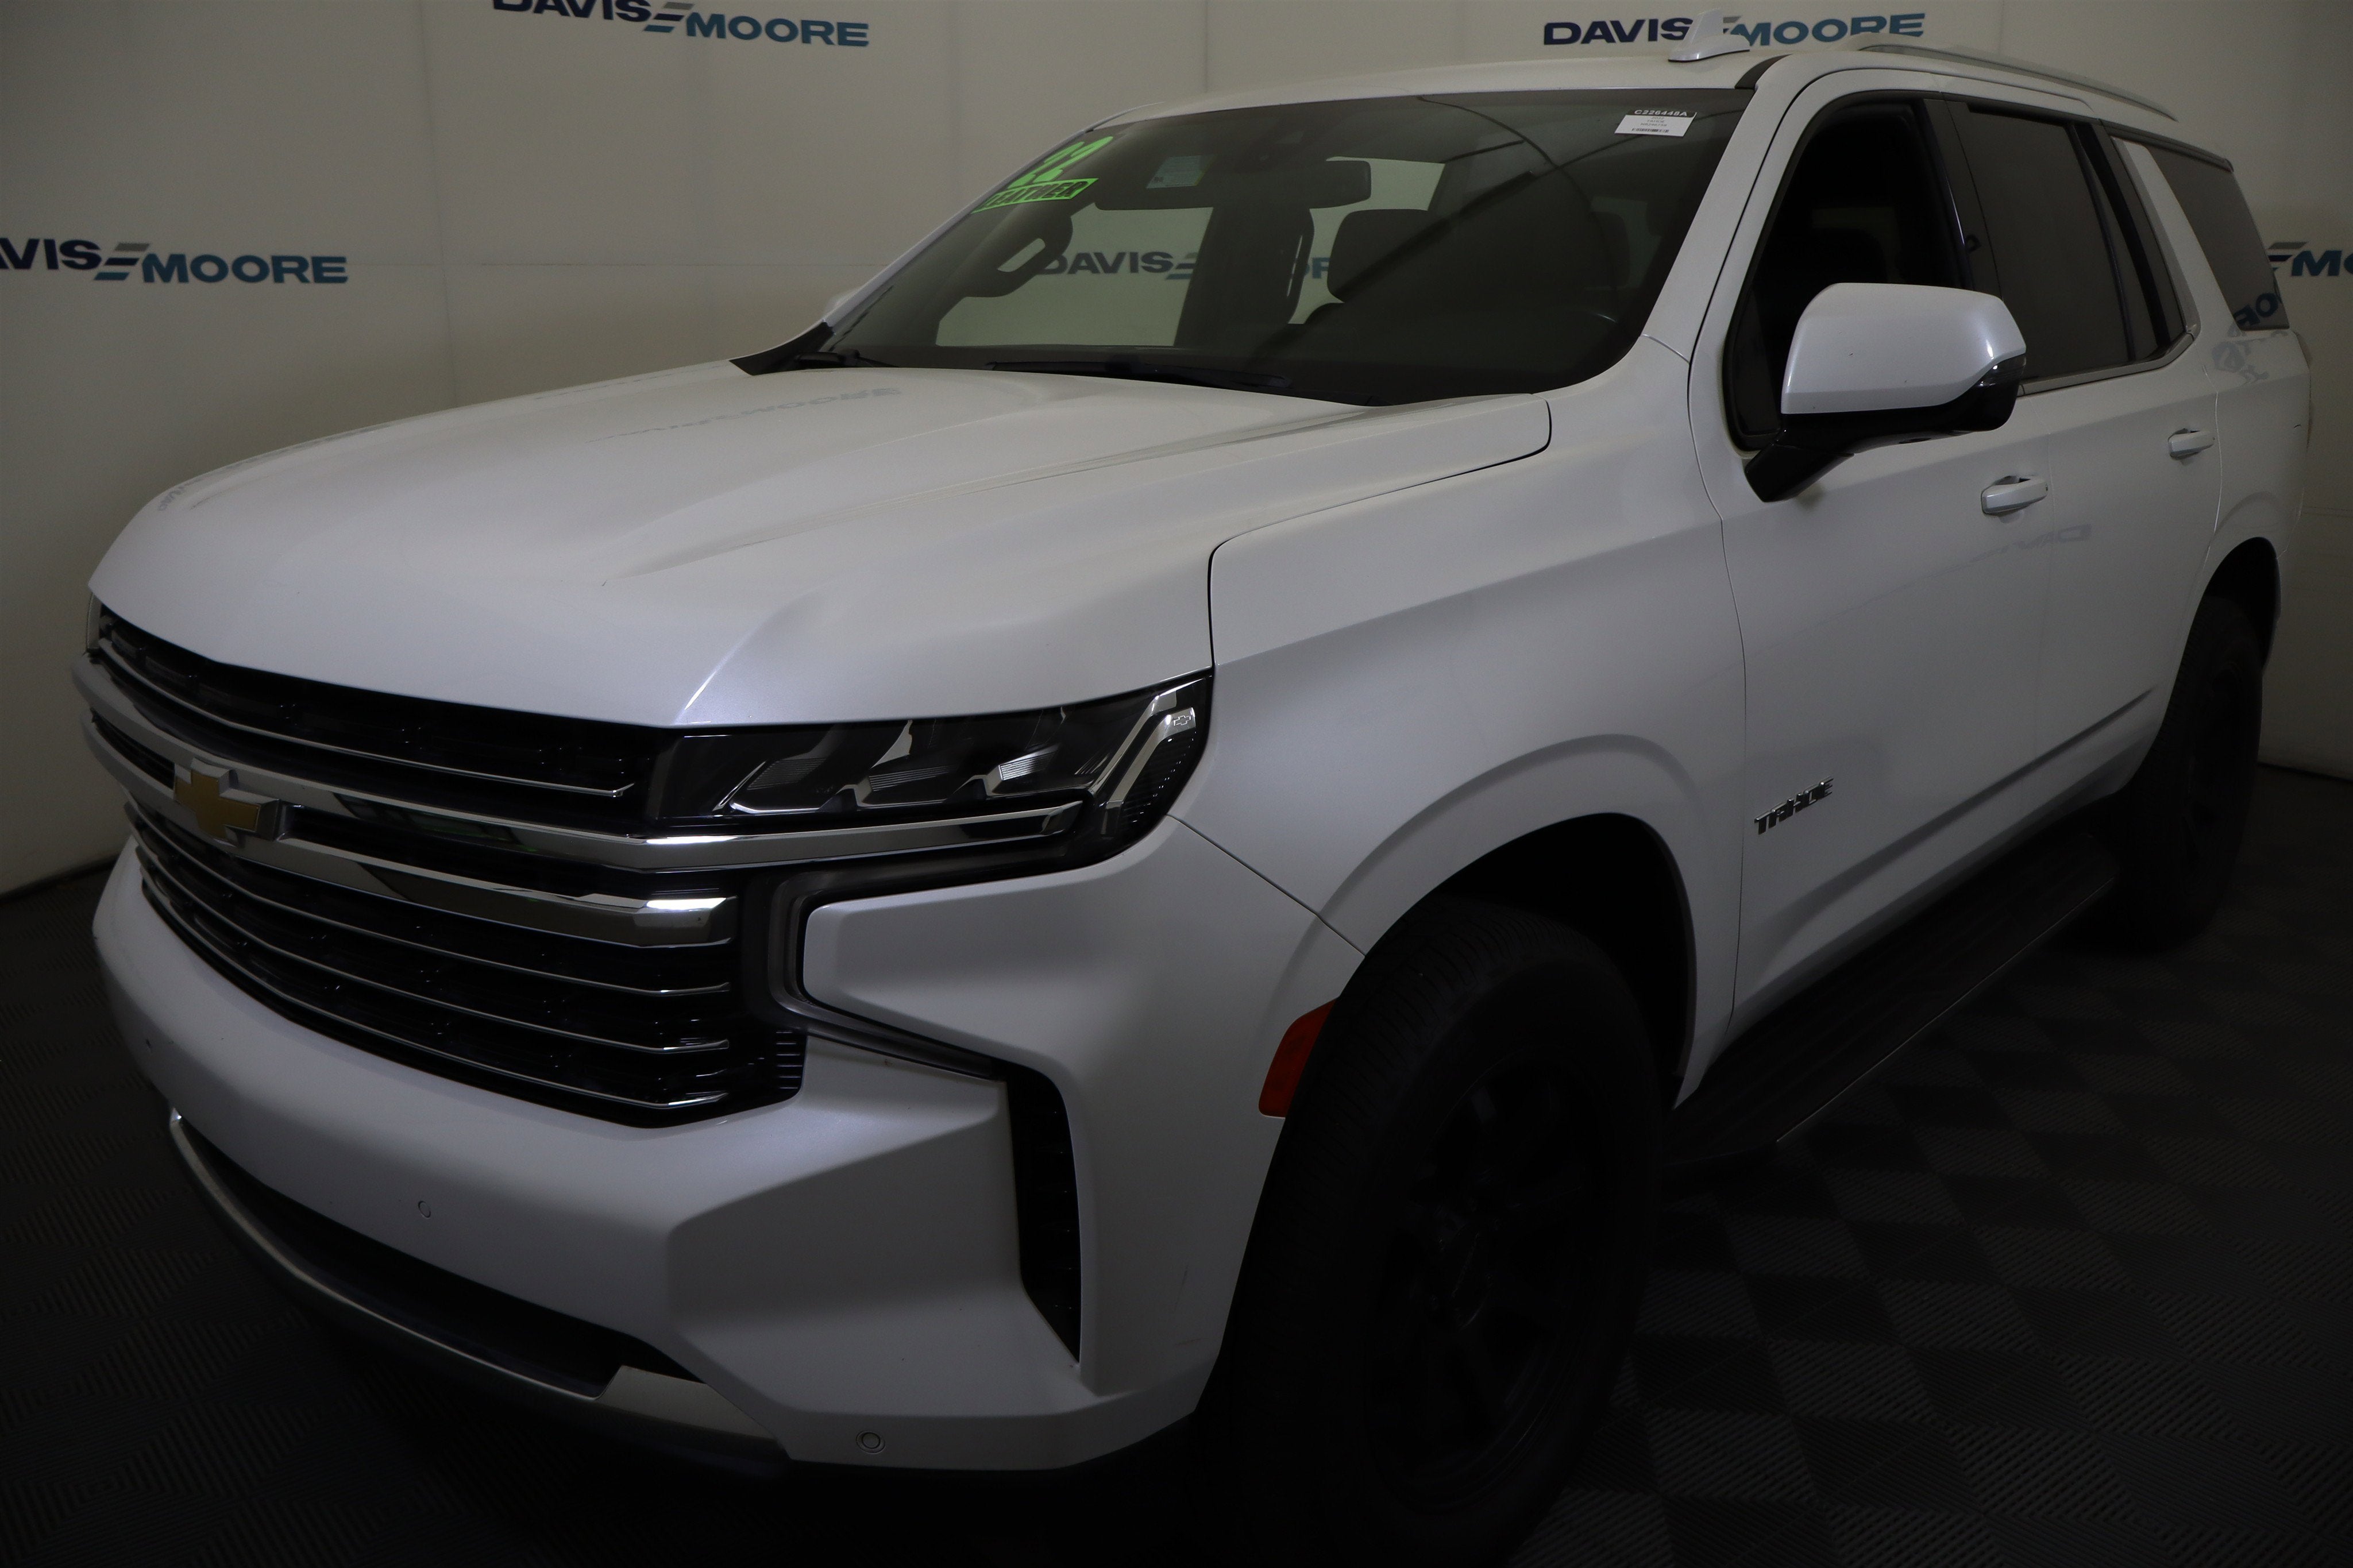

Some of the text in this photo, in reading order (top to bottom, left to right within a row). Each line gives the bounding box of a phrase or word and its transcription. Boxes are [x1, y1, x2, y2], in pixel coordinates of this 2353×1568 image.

[686, 11, 869, 47] MOORE
[1544, 13, 1926, 47] DAVIS MOORE
[0, 238, 348, 284] VIS MOORE
[1754, 776, 1834, 835] TAHOE
